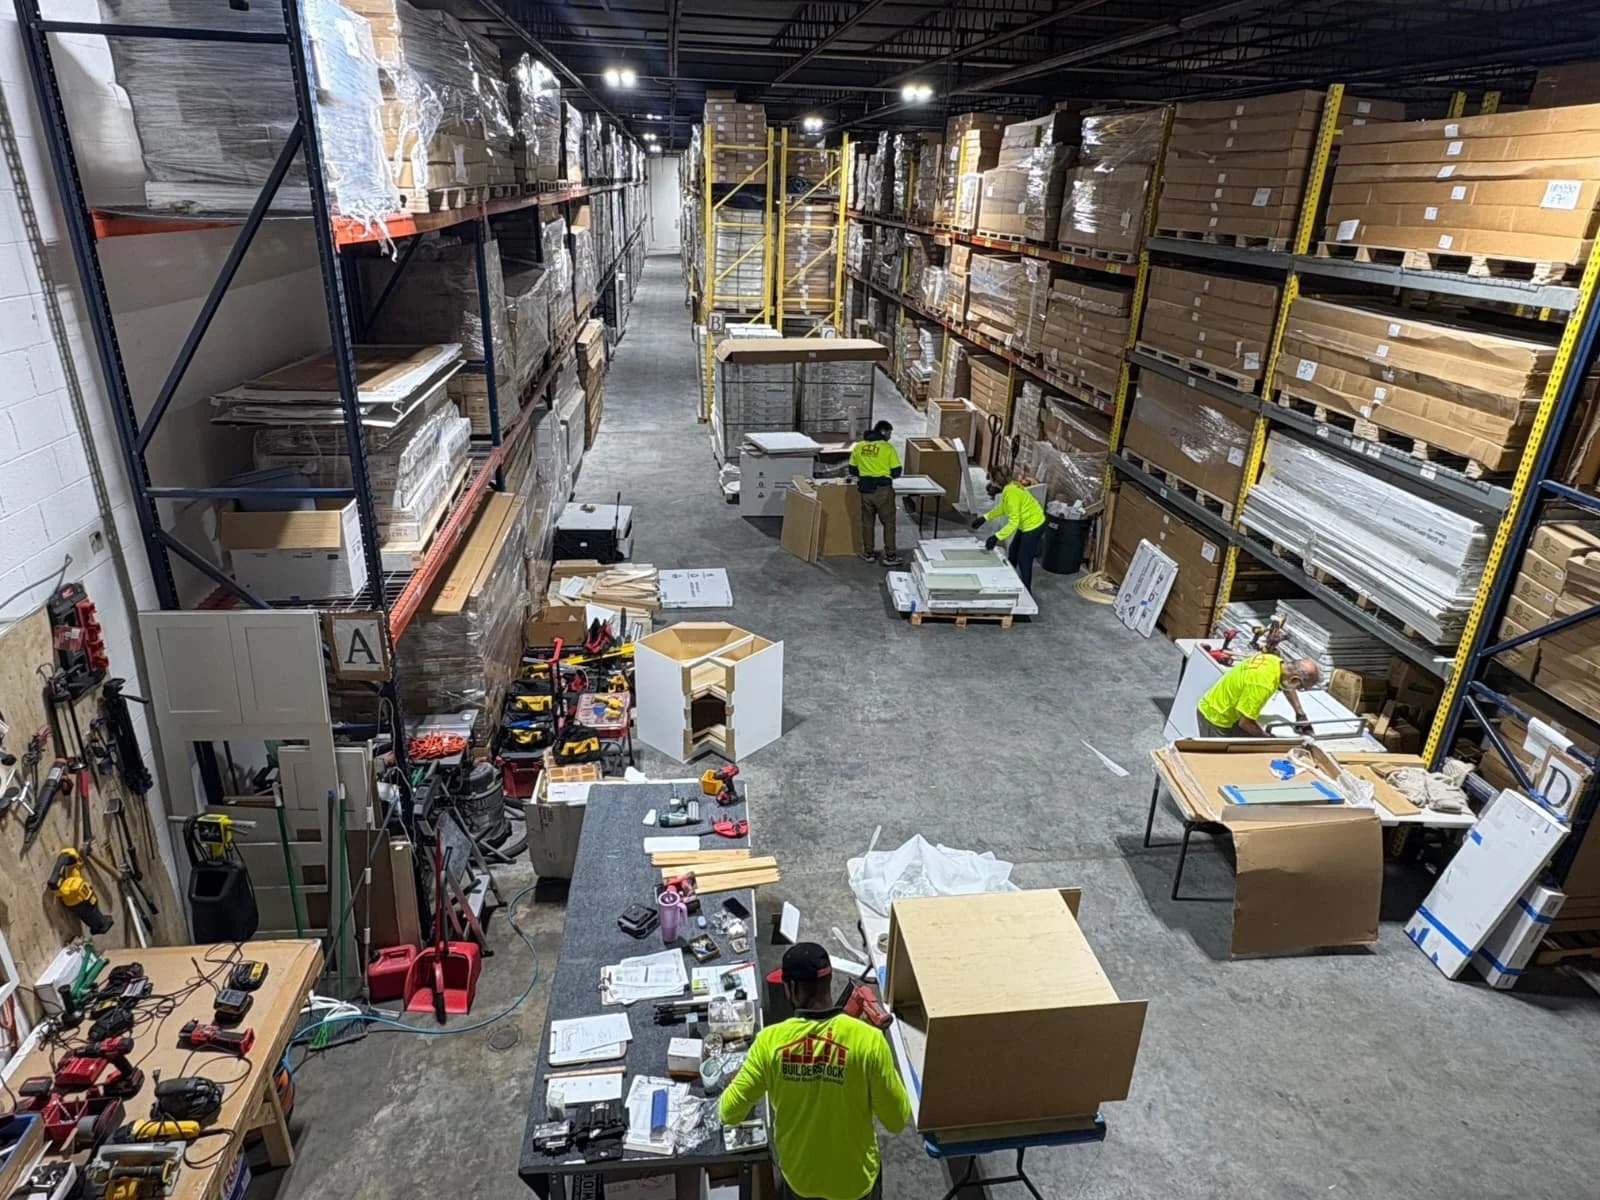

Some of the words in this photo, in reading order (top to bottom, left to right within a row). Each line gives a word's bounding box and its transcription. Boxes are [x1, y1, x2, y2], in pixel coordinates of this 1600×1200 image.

[711, 315, 721, 331] B
[344, 628, 381, 664] A
[1540, 764, 1572, 809] D
[782, 1062, 845, 1079] BUILDERSTOCK
